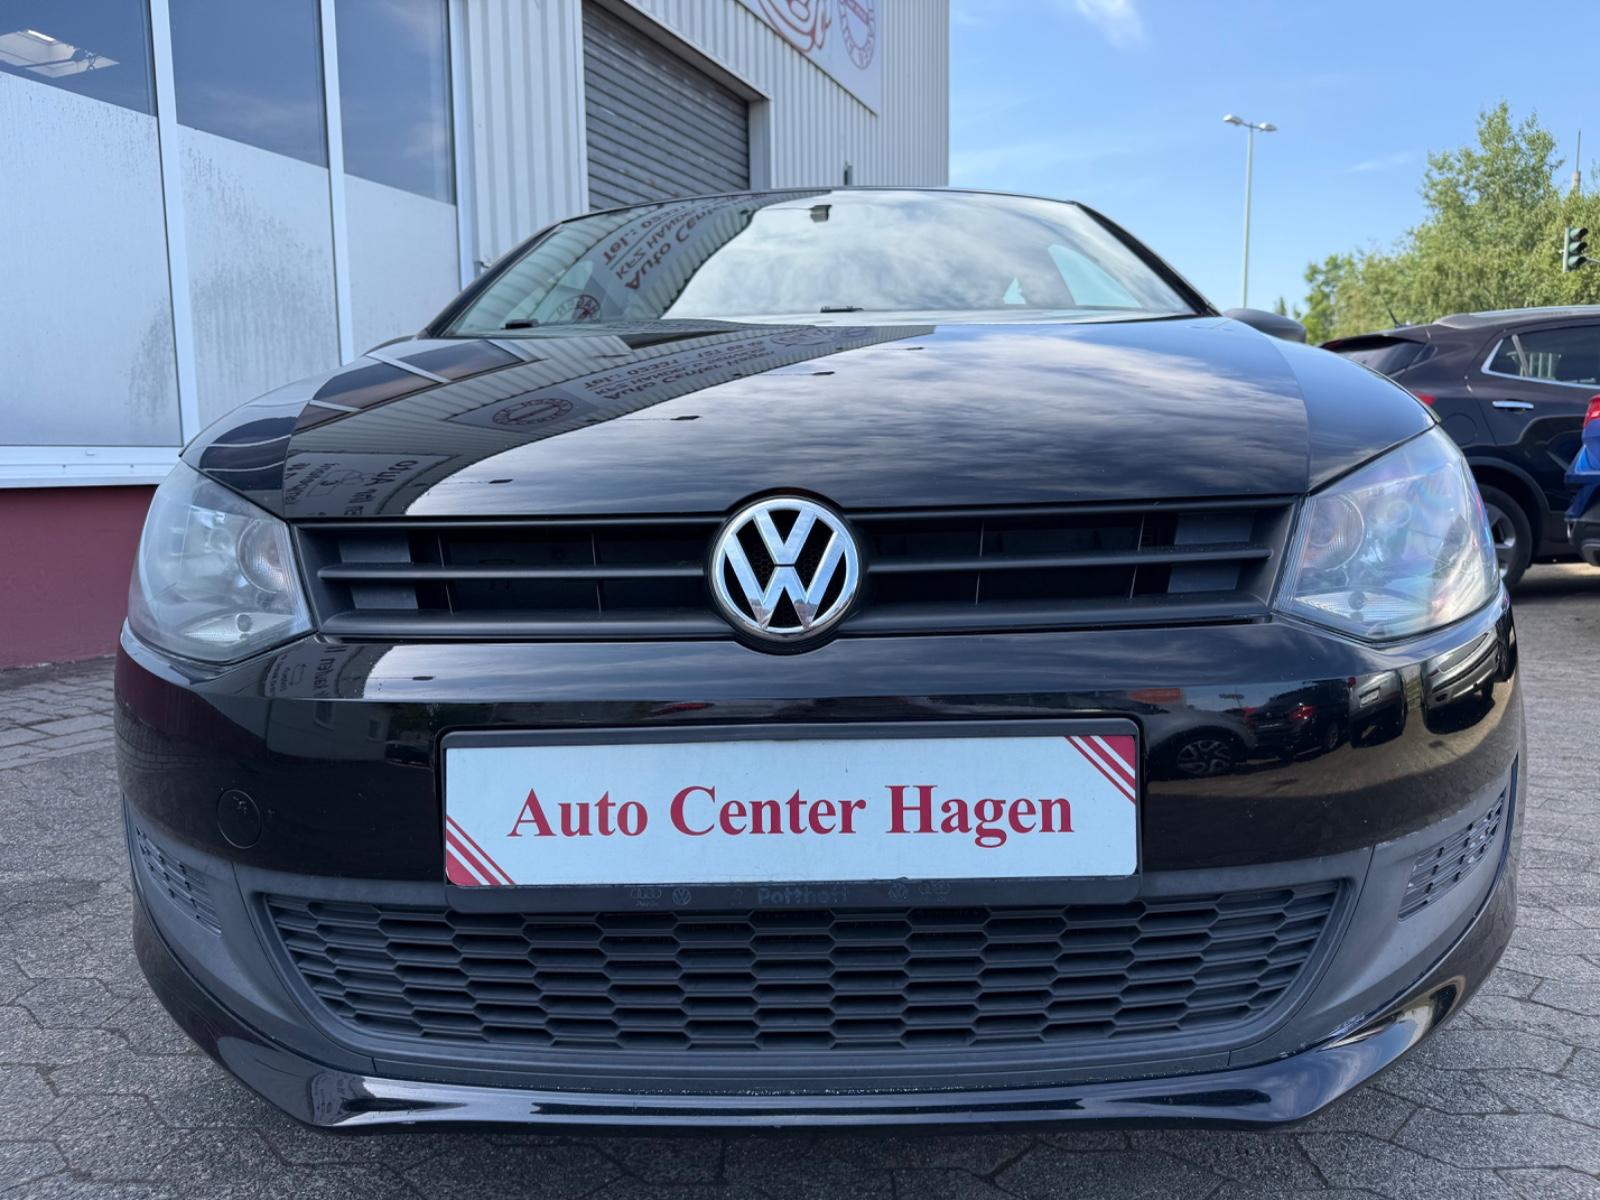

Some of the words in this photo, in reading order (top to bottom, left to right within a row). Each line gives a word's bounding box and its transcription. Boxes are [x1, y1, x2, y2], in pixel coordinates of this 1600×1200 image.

[713, 498, 859, 639] VW
[507, 788, 648, 838] Auto
[669, 785, 867, 835] Center
[884, 784, 1075, 848] Hagen
